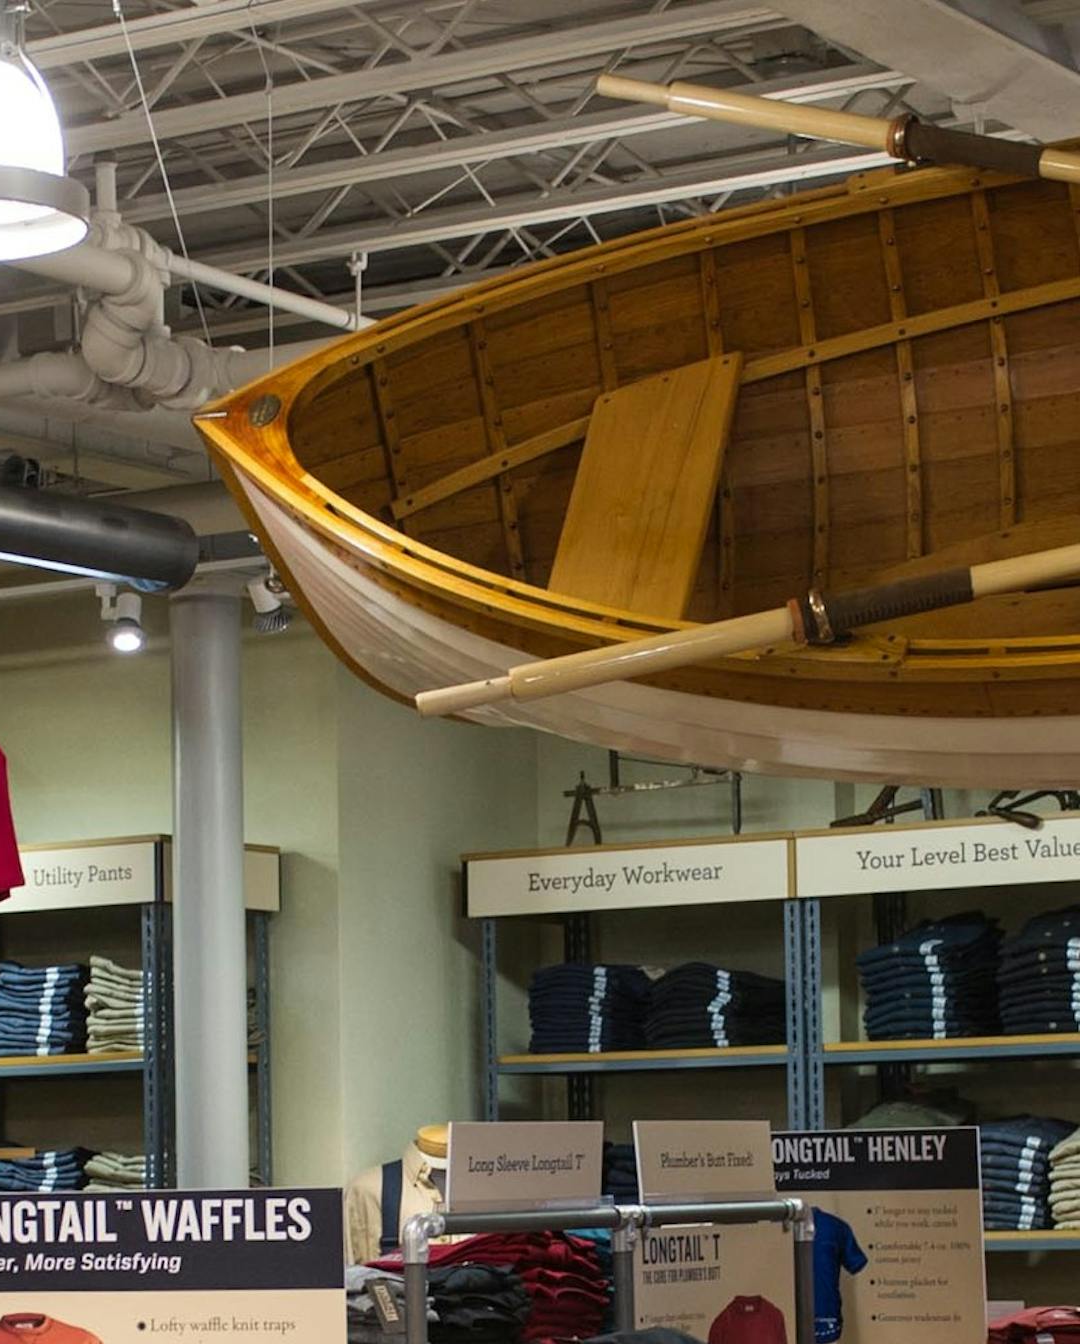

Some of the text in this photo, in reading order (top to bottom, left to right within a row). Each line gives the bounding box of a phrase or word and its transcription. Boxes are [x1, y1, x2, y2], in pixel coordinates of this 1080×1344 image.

[856, 835, 1080, 871] Your Level Best Value
[33, 864, 133, 888] Utility Pants
[528, 862, 723, 894] Everyday Workwear
[660, 1152, 704, 1169] Plumber's
[707, 1153, 725, 1168] Butt
[868, 1135, 947, 1162] HENLEY
[468, 1155, 495, 1176] Long
[497, 1155, 529, 1172] Sleeve
[532, 1154, 573, 1175] Longtail
[793, 1168, 830, 1180] Tucked
[140, 1198, 312, 1242] WAFFLES
[713, 1234, 720, 1261] T
[25, 1253, 75, 1271] More
[81, 1252, 182, 1273] Satisfying
[150, 1317, 296, 1335] Lofty waffle knit traps
